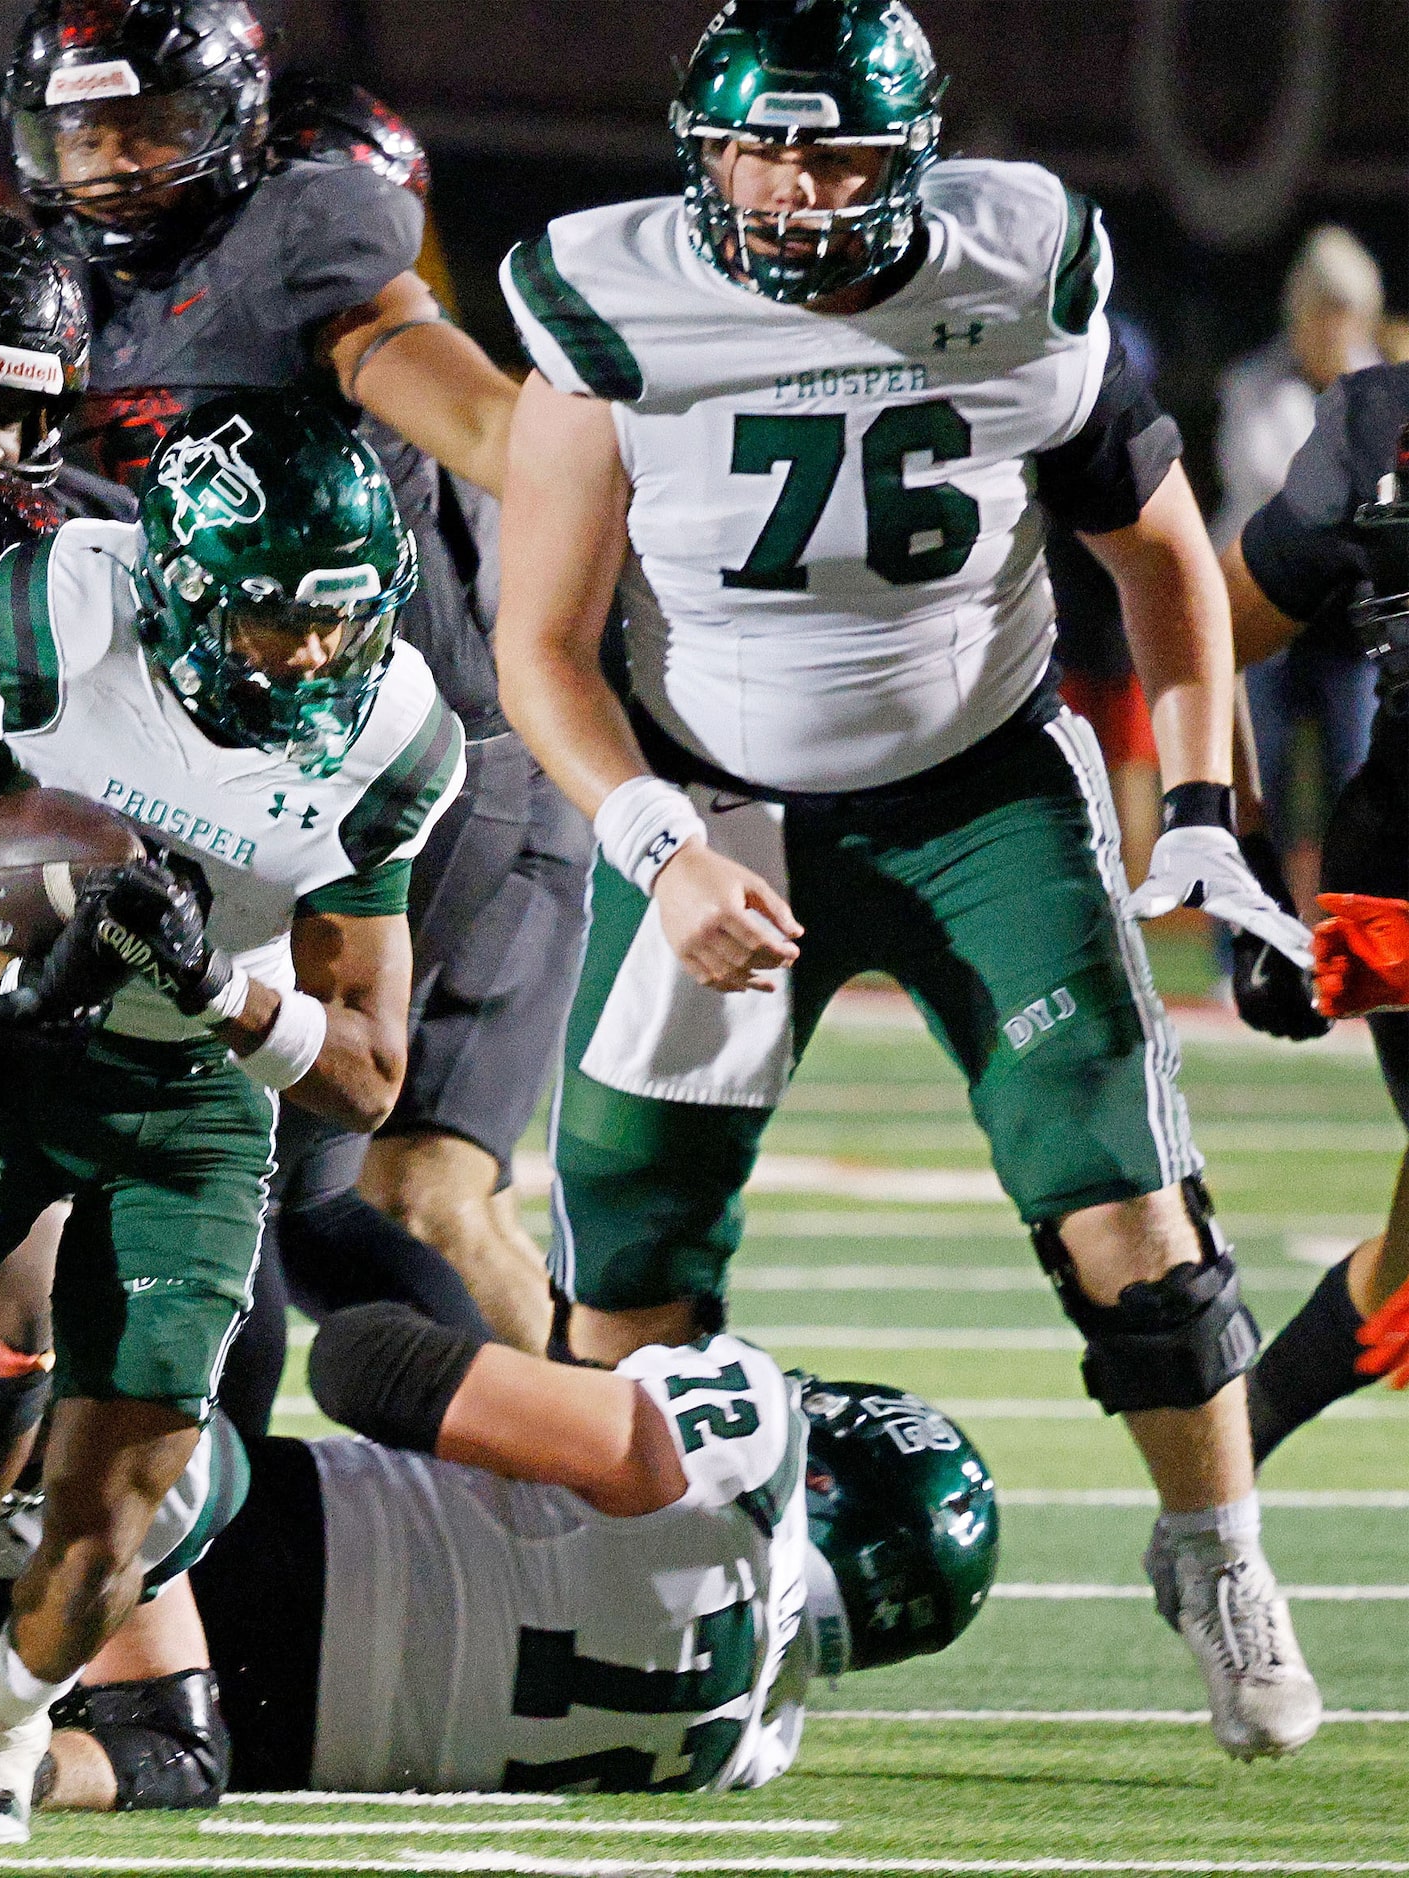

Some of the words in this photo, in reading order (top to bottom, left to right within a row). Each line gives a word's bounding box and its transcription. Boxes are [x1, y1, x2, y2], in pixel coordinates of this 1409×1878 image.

[774, 363, 928, 399] PROSPER
[719, 396, 980, 590] 76
[101, 777, 258, 866] PROSPER
